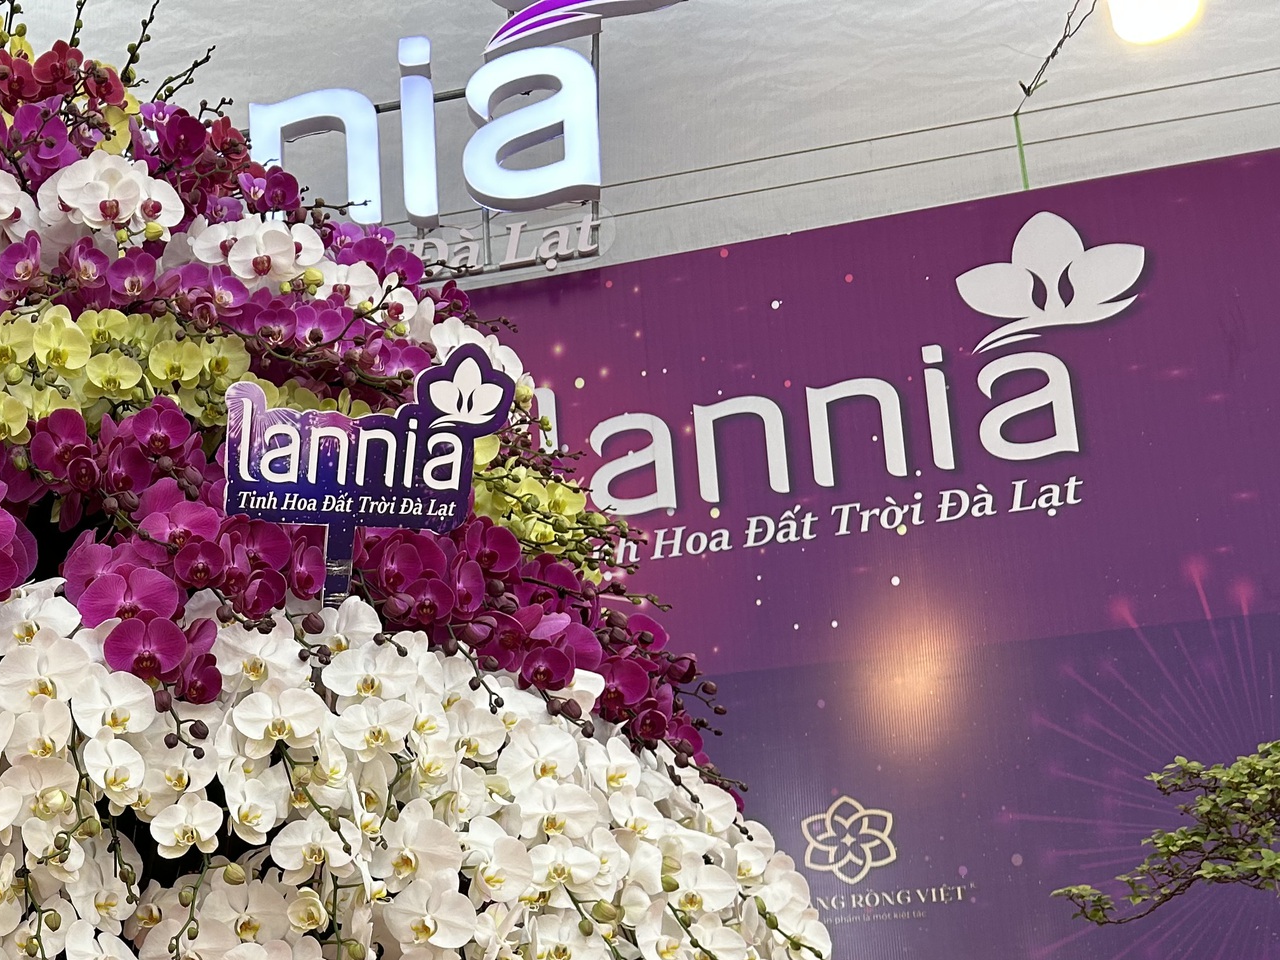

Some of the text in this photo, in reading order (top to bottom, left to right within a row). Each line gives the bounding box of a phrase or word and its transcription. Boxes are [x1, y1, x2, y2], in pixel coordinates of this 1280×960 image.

[249, 36, 601, 227] nia
[499, 213, 601, 271] Lạt
[238, 398, 463, 490] lannia
[237, 491, 456, 521] Tinh Hoa Đất Trời Đà Lạt
[651, 524, 732, 561] Hoa
[743, 504, 818, 549] Đất
[831, 491, 925, 536] Trời
[936, 482, 999, 523] Đà
[1009, 476, 1084, 518] Lạt
[816, 893, 845, 911] NG
[916, 883, 967, 905] VIỆT
